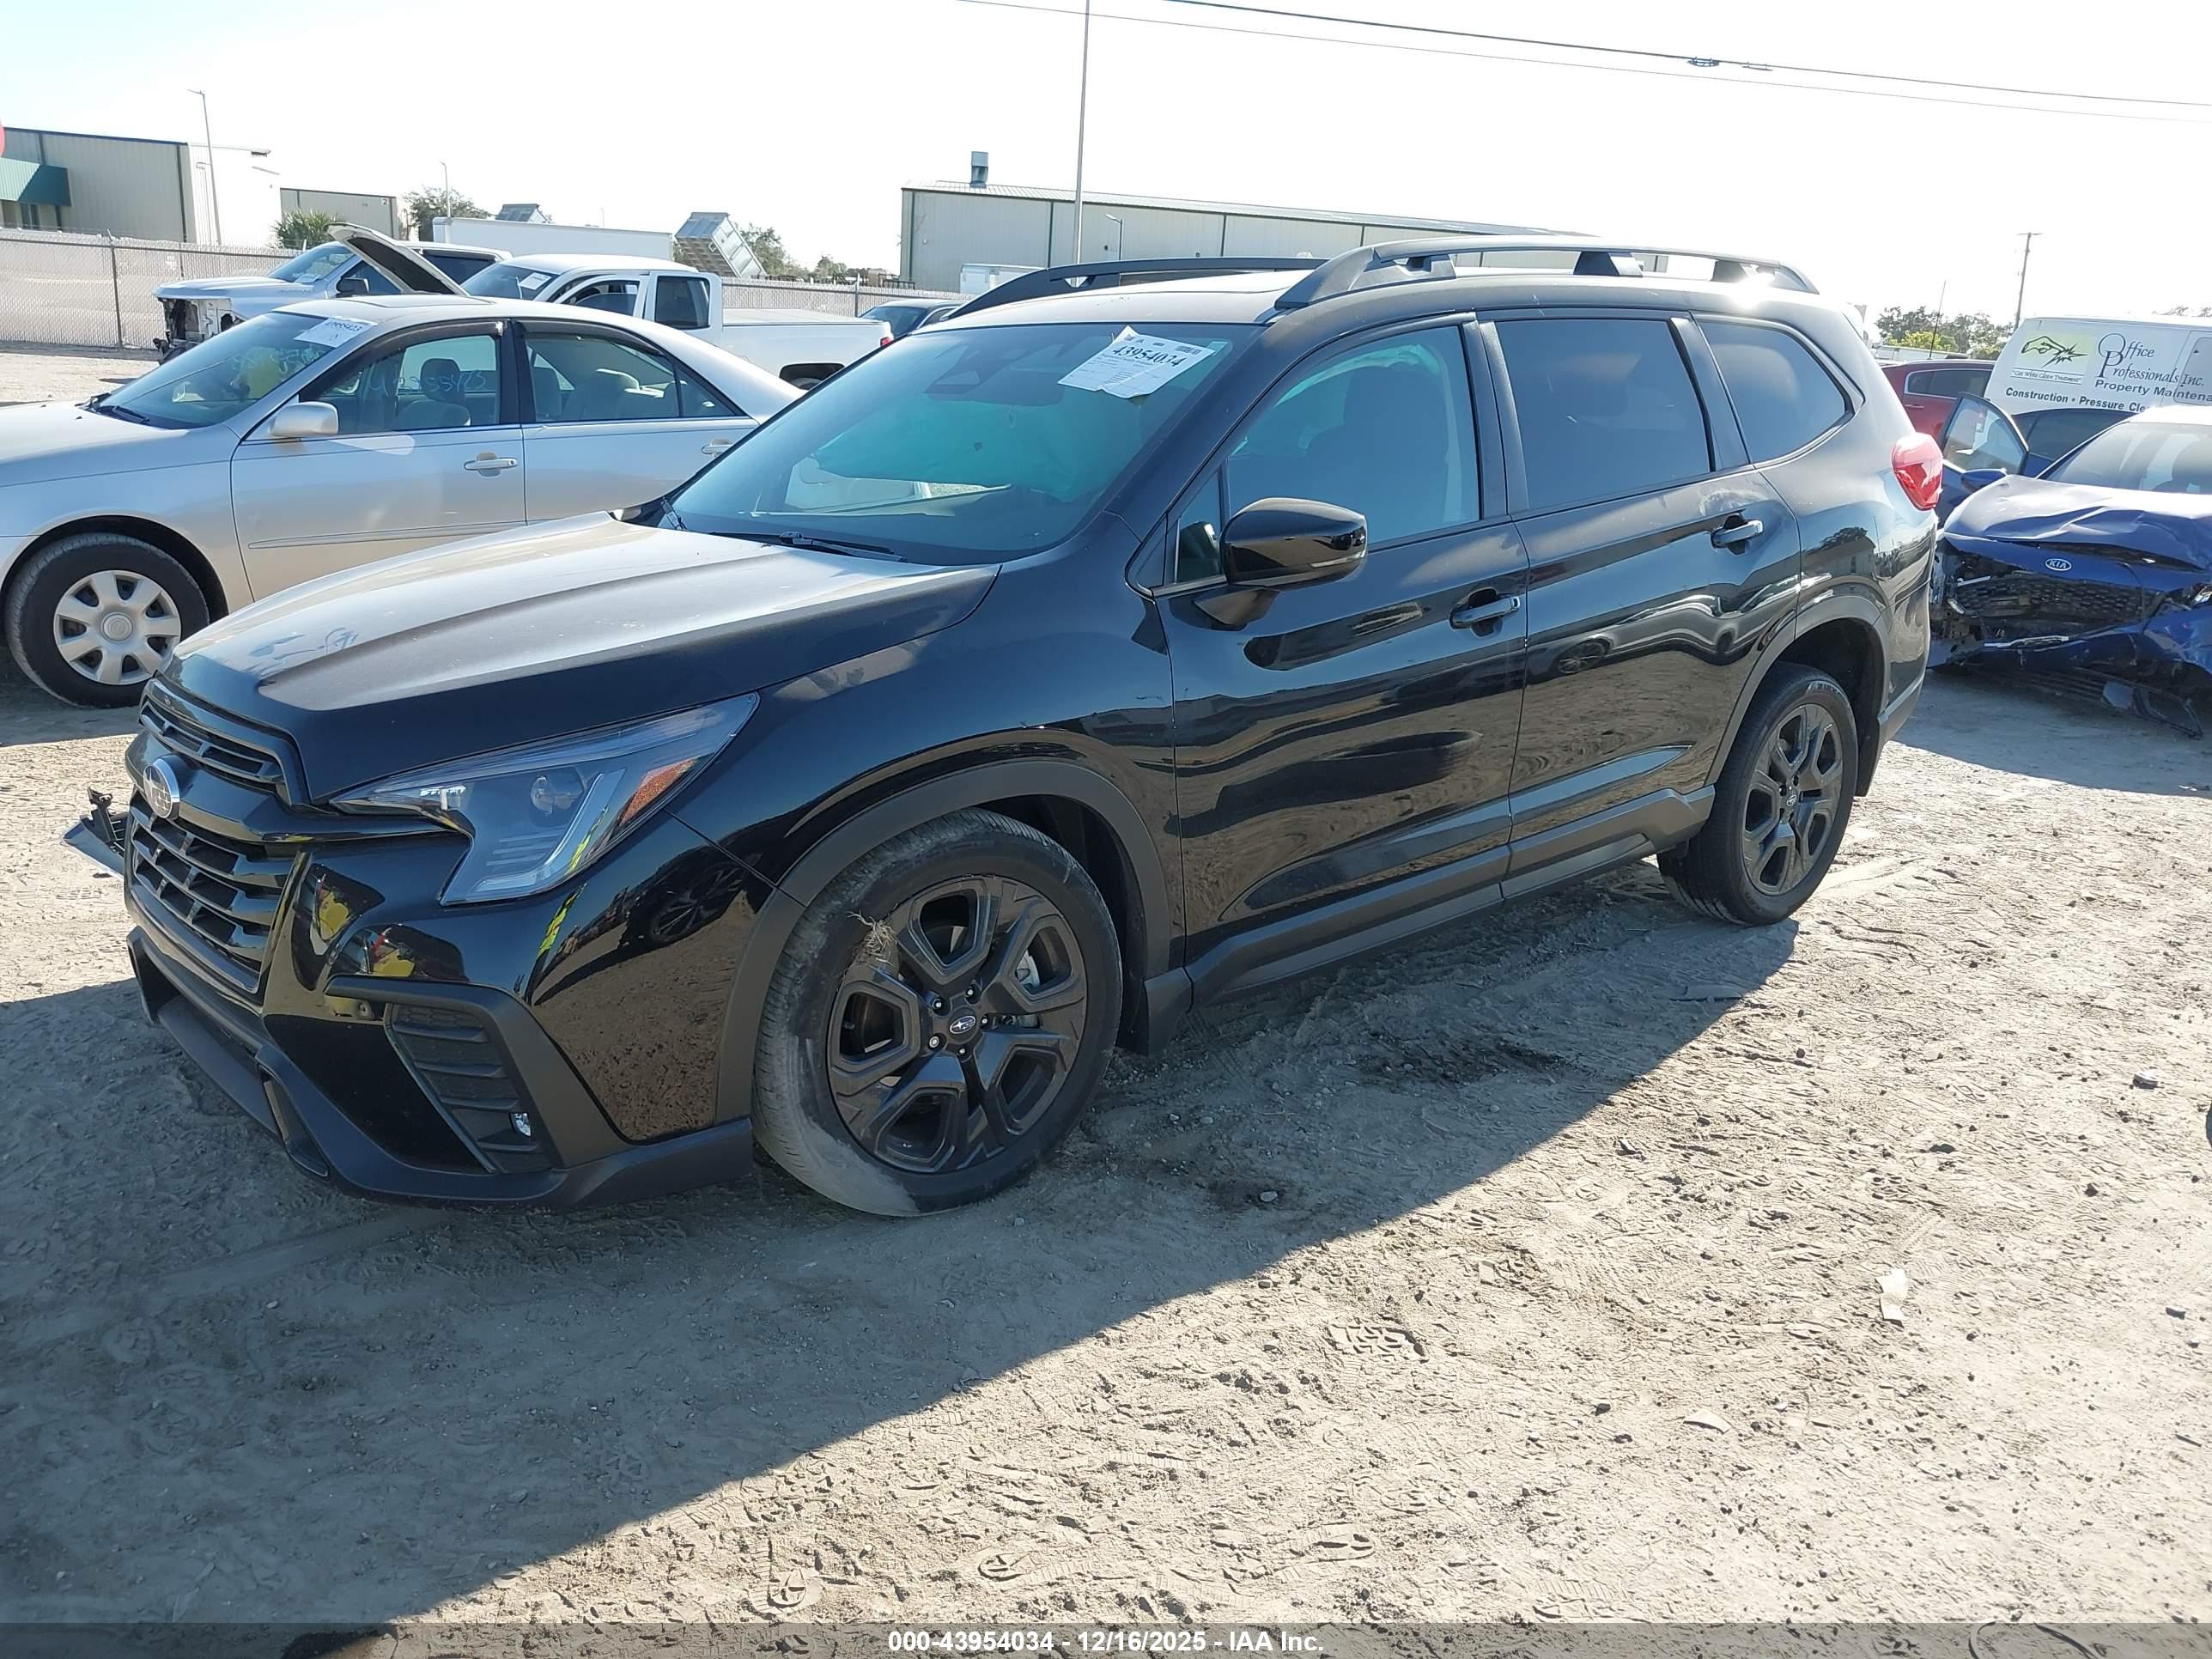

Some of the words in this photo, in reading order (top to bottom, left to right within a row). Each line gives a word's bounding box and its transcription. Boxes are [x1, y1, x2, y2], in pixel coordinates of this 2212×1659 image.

[1113, 345, 1188, 368] 43954034
[2098, 333, 2155, 359] Office
[2095, 350, 2180, 383] Professionals
[2182, 374, 2205, 386] Inc.
[2005, 387, 2069, 403] Construction
[2079, 396, 2125, 410] Pressure
[2129, 402, 2150, 412] Cle
[2095, 380, 2150, 395] Property
[2049, 560, 2067, 568] KIA
